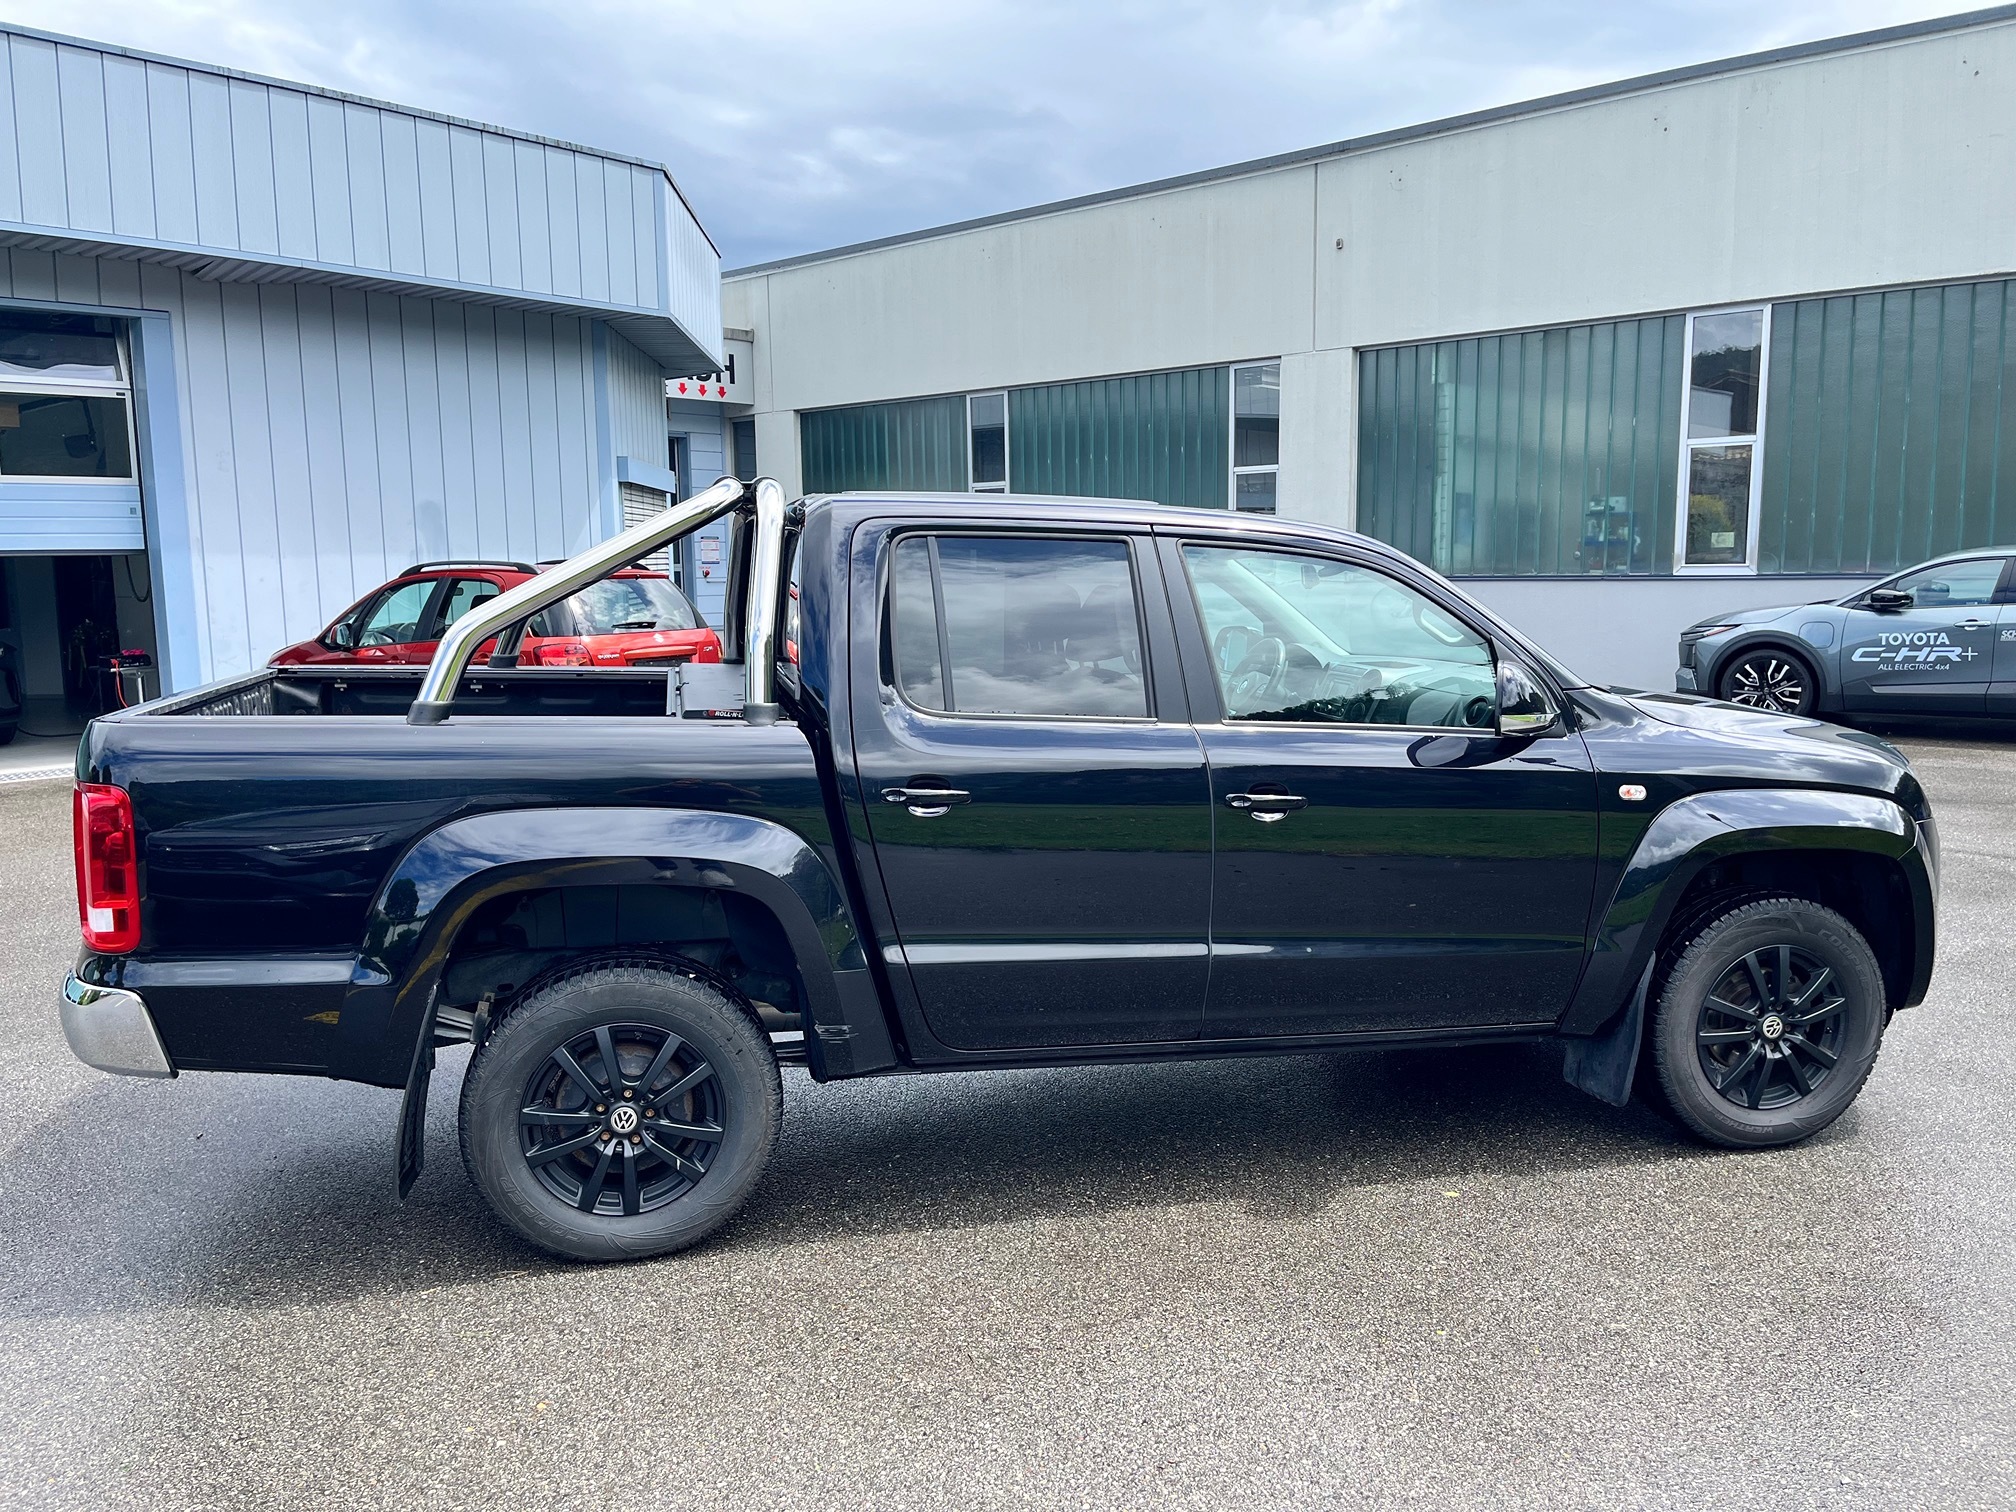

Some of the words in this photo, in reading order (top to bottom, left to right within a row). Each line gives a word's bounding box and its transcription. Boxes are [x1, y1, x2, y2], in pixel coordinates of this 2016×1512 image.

[1878, 632, 1950, 645] TOYOTA
[1851, 646, 1978, 662] C-HR+
[1877, 663, 1893, 671] ALL
[1894, 663, 1933, 671] ELECTRIC
[1934, 663, 1950, 671] 4x4
[611, 1106, 637, 1133] VW
